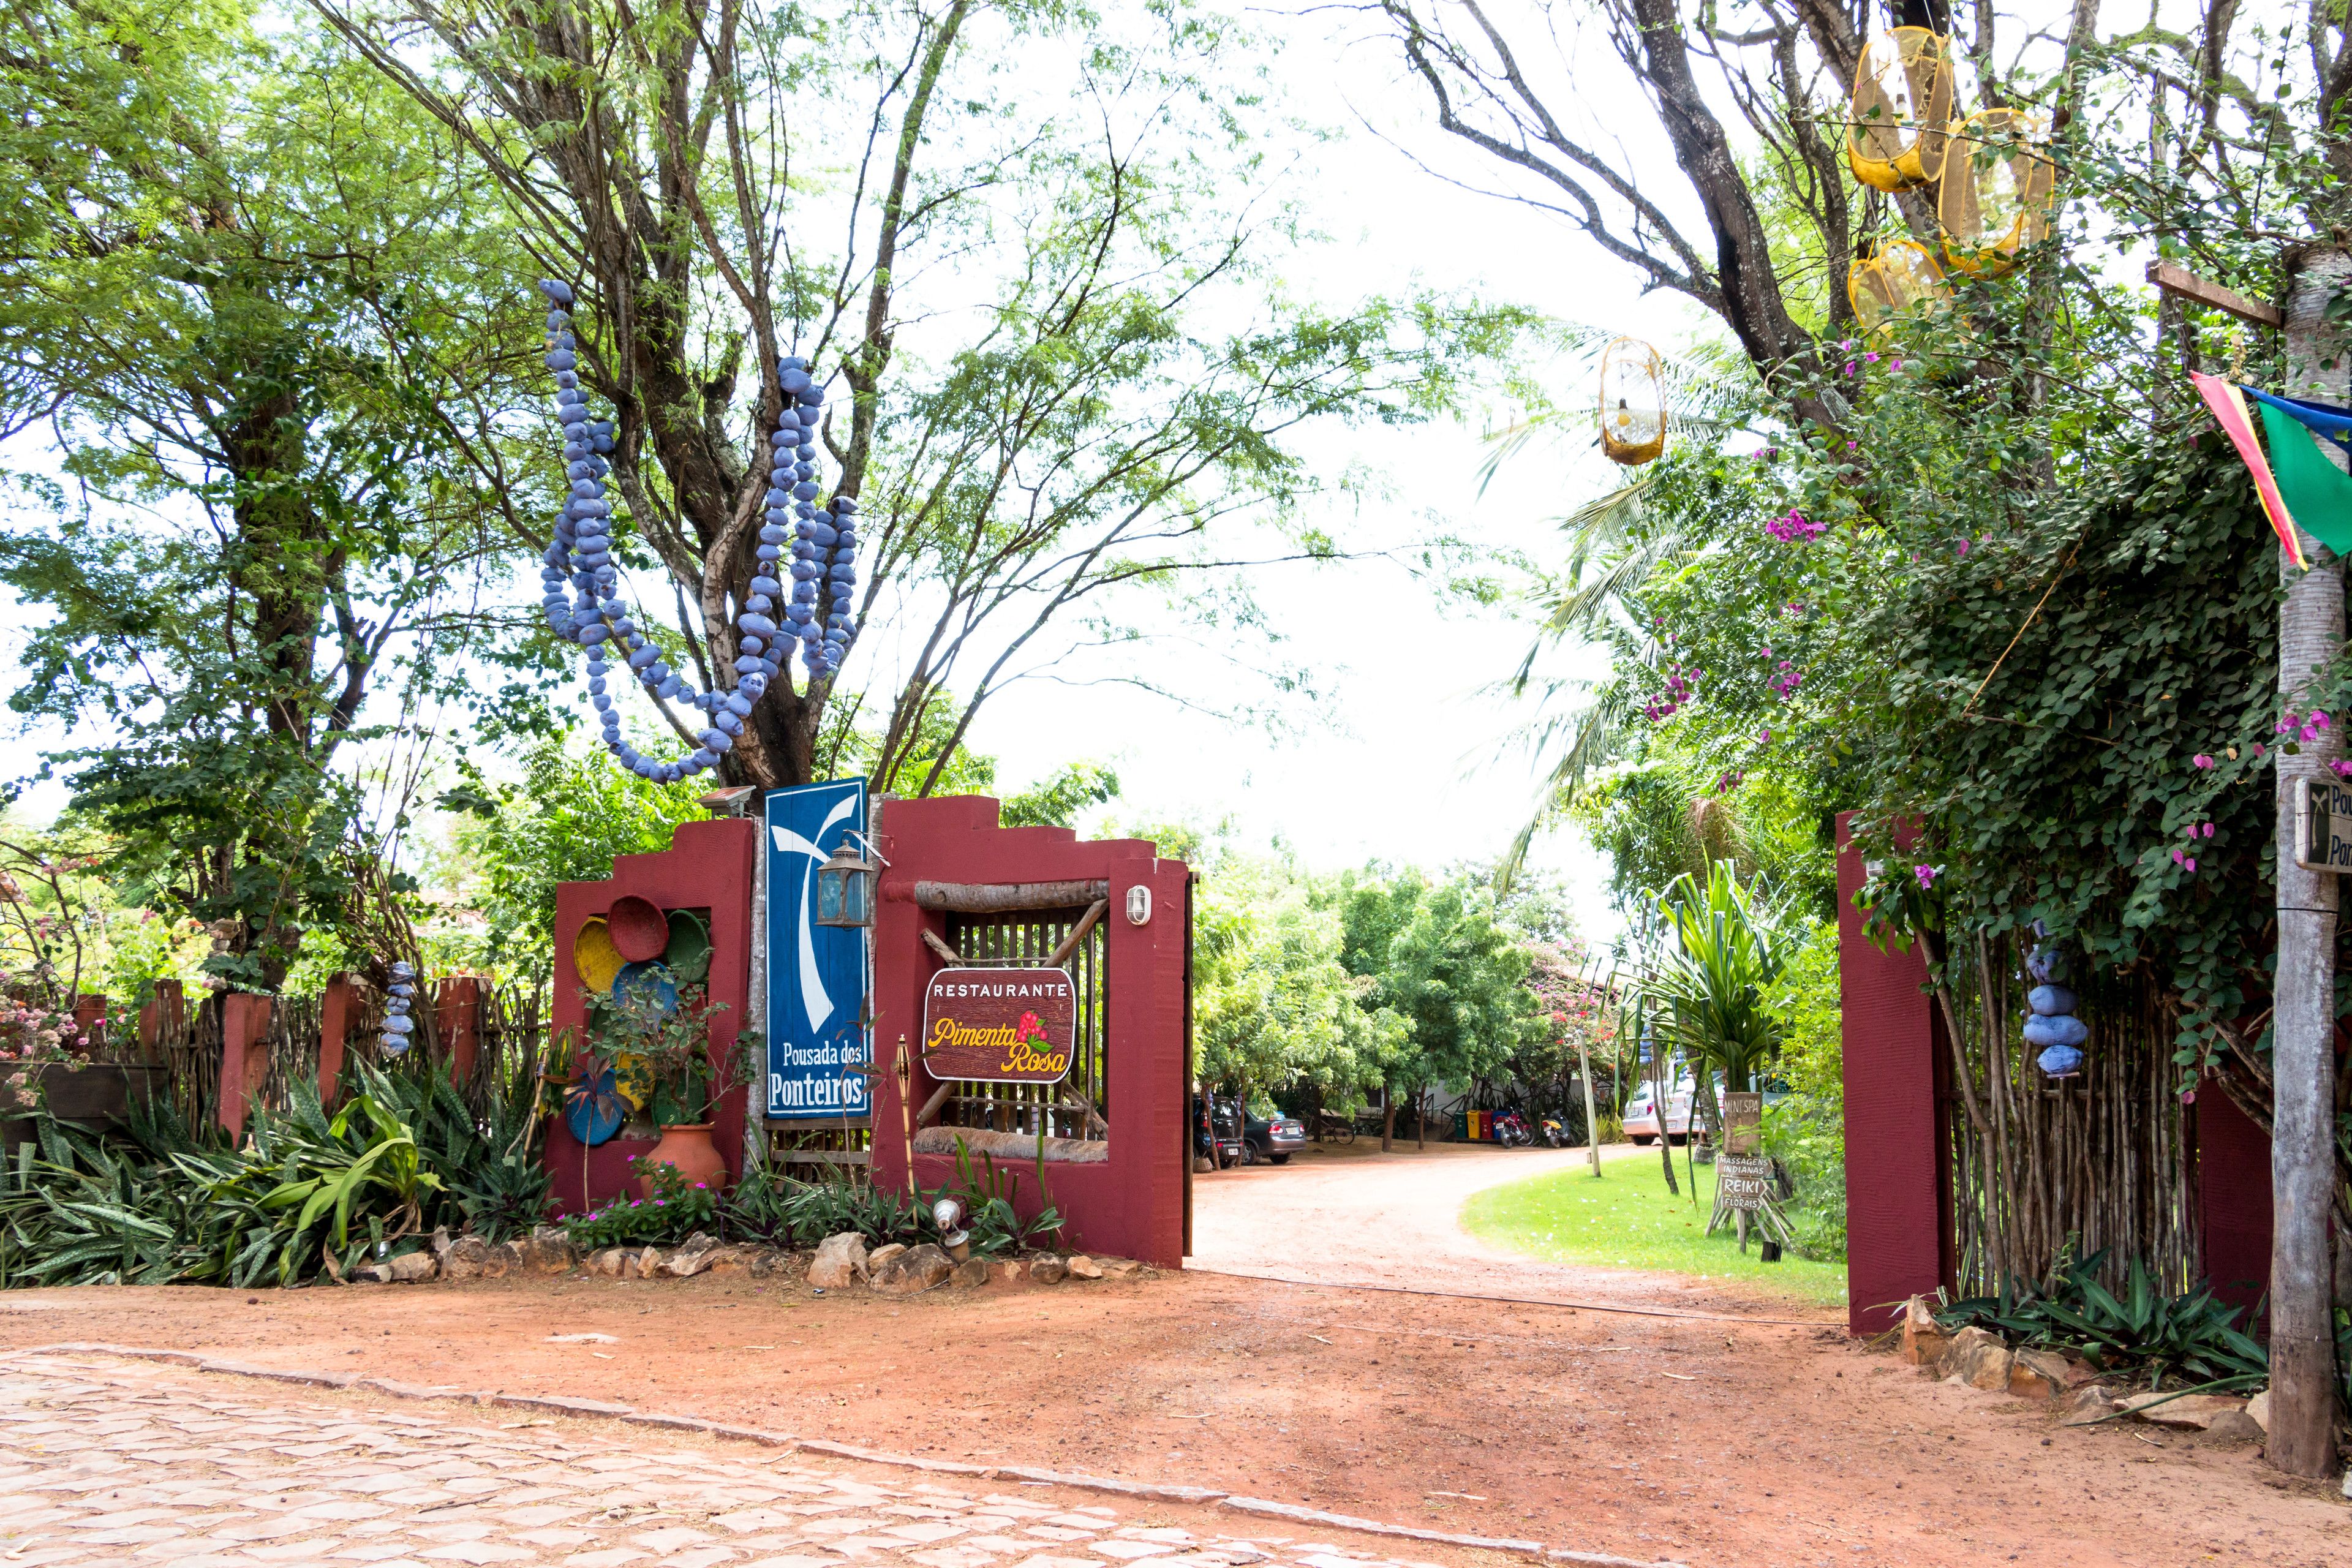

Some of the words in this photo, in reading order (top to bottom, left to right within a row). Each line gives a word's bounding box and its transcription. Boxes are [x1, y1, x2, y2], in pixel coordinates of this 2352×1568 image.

[934, 984, 1067, 997] RESTAURANTE
[927, 1017, 1019, 1047] Pimenta
[783, 1040, 839, 1066] Pousada
[840, 1039, 862, 1063] dos
[1000, 1042, 1067, 1072] Rosa
[771, 1072, 862, 1106] Ponteiros
[1724, 1100, 1743, 1113] MINI
[1744, 1099, 1758, 1113] SPA
[1719, 1155, 1768, 1166] MASSAGENS
[1723, 1166, 1764, 1175] INDIANAS
[1724, 1177, 1759, 1194] REIKI
[1725, 1198, 1757, 1208] FLORAIS
